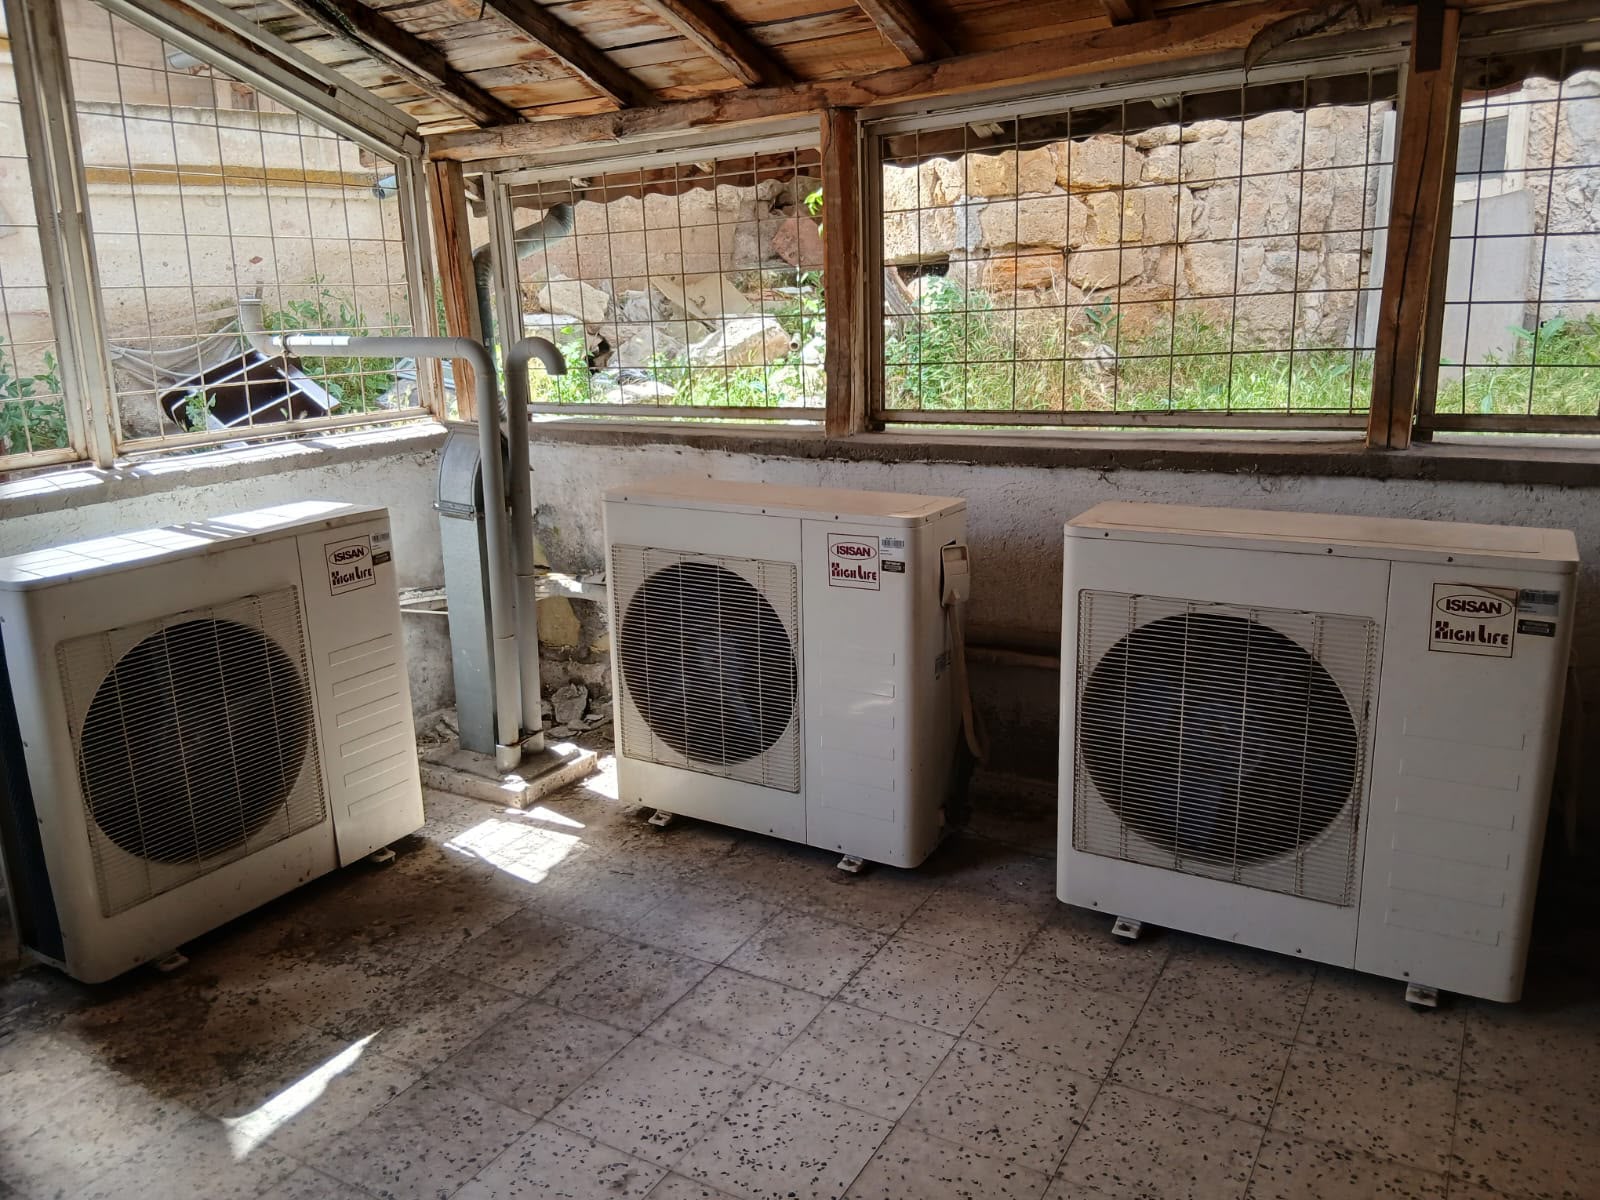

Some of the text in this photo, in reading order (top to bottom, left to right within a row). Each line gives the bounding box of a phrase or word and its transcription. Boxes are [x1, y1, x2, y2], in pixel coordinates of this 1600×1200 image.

[334, 547, 364, 562] ISISAN
[836, 545, 871, 557] ISISAN
[1446, 599, 1502, 614] ISISAN
